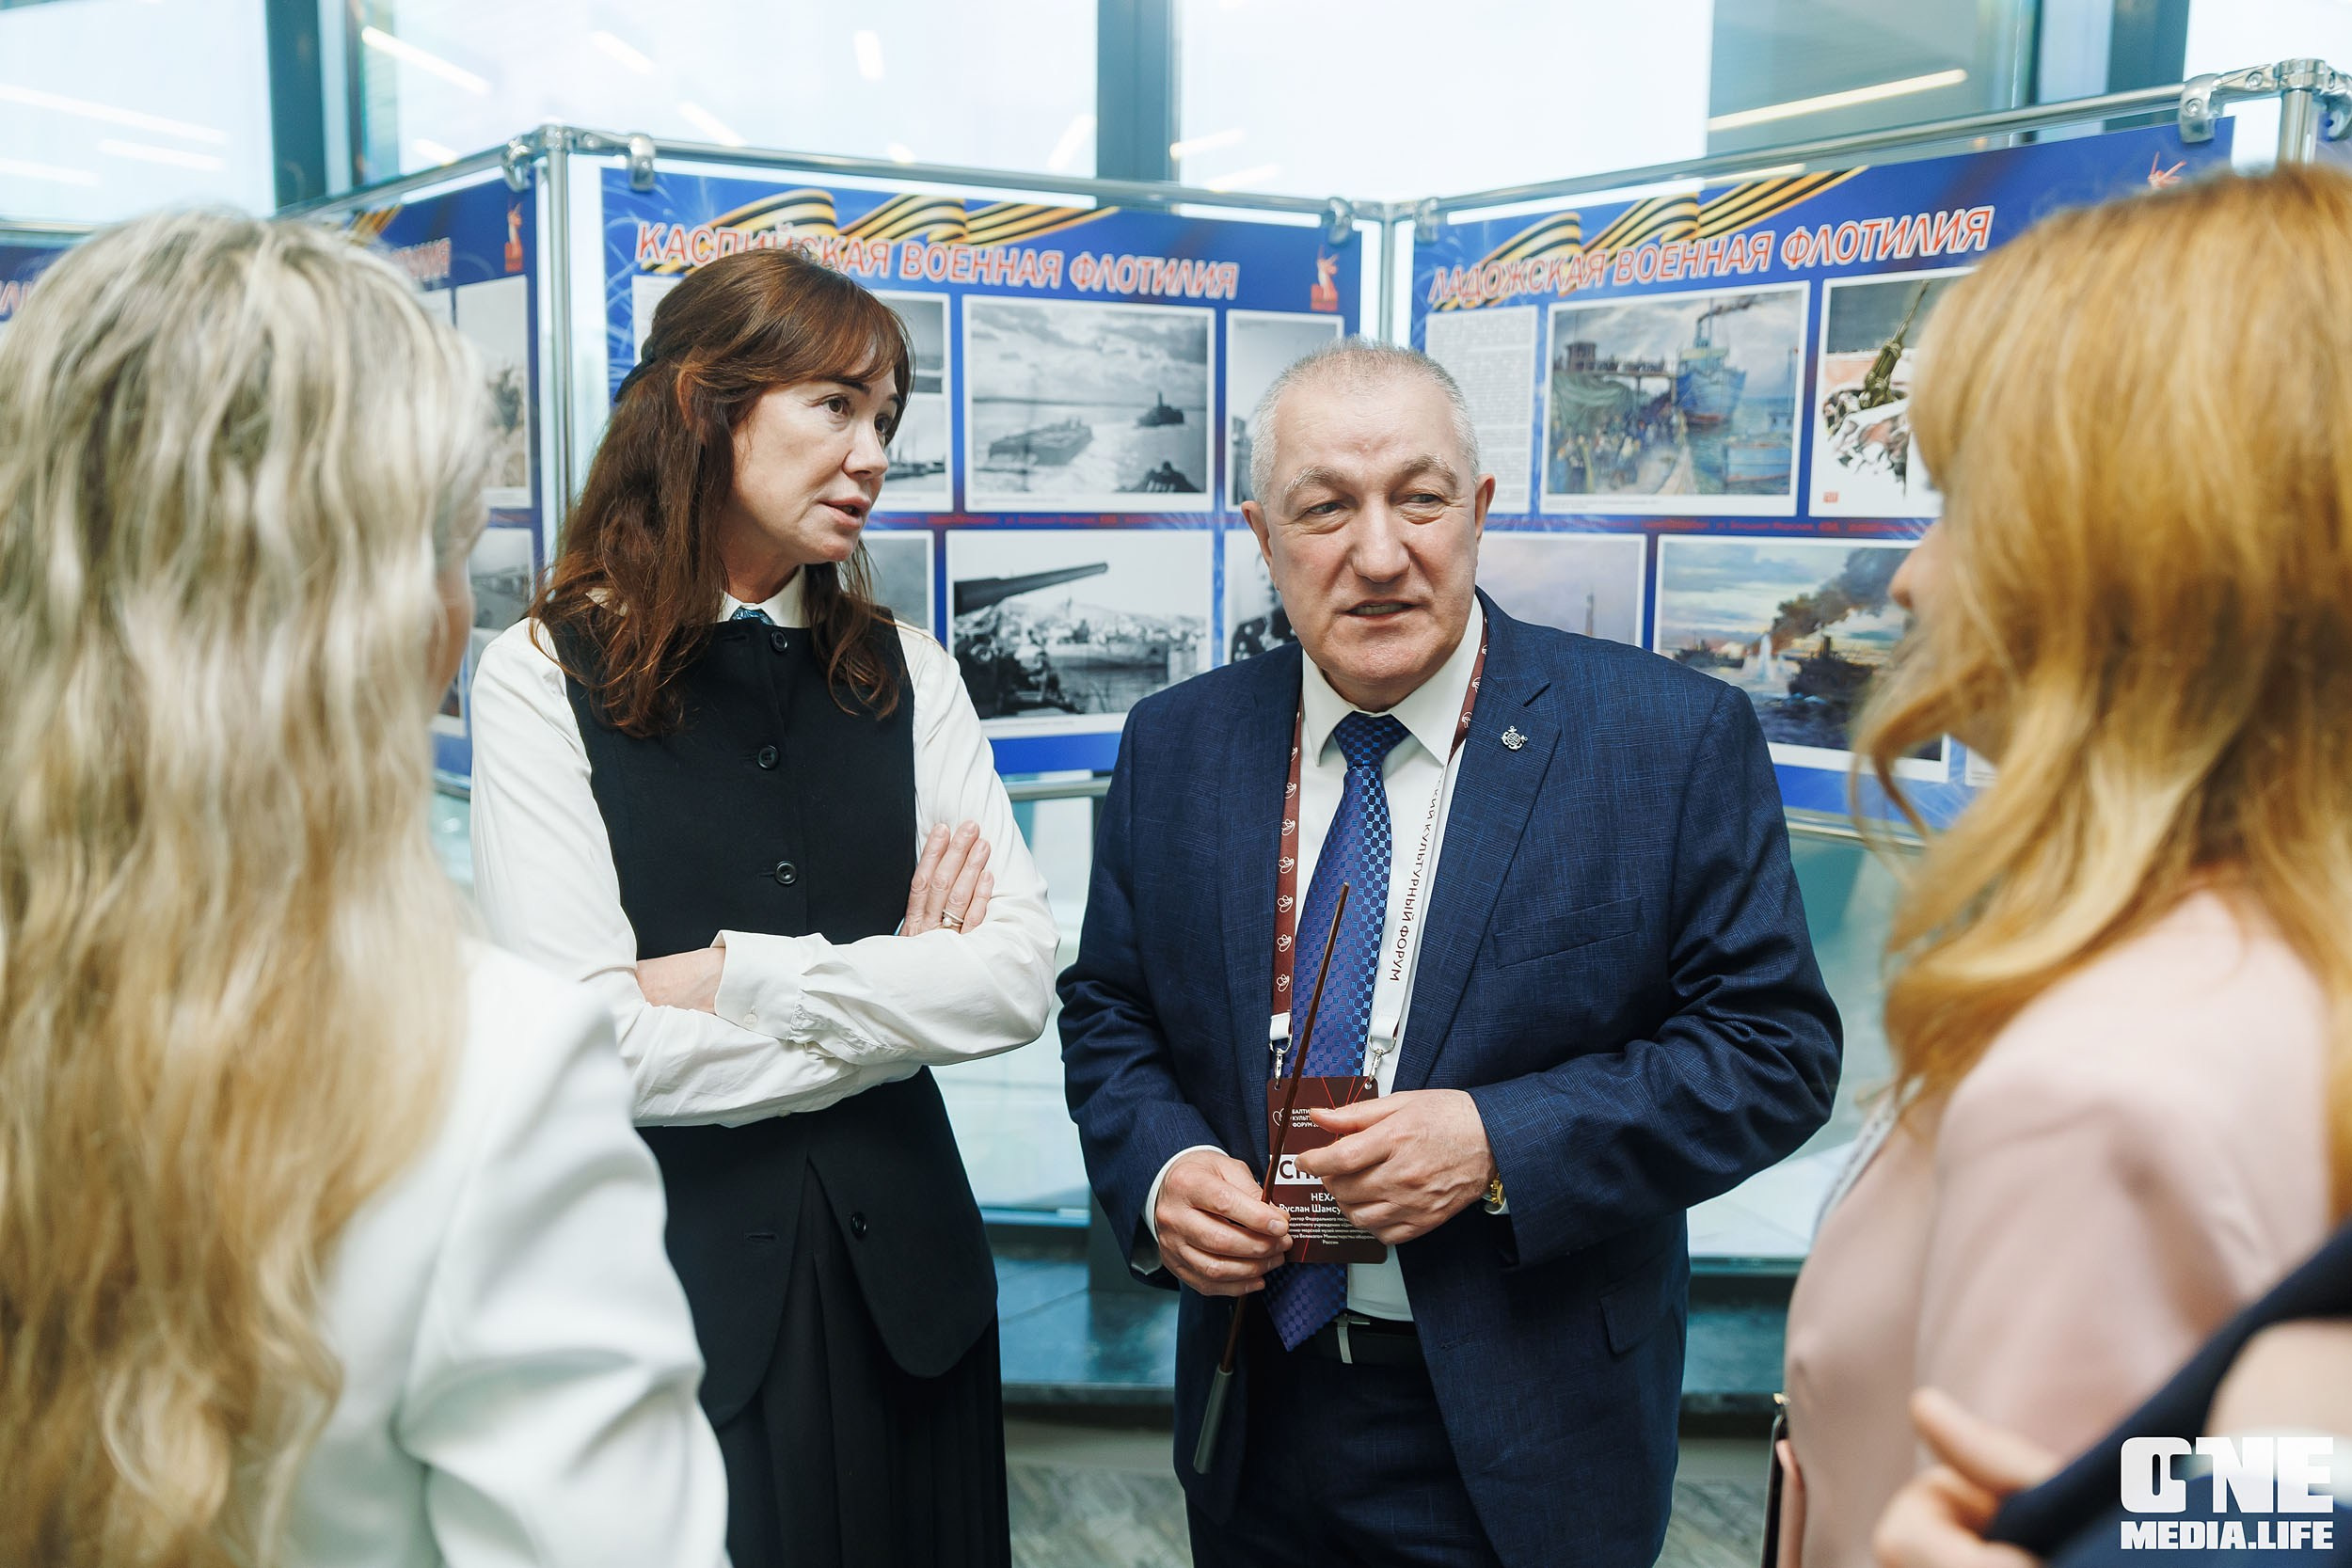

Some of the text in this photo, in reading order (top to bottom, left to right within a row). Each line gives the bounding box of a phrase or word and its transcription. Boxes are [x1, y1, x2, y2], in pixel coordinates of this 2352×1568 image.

[898, 240, 1064, 290] ВОЕННАЯ
[1070, 251, 1240, 300] ФЛОТИЛИЯ
[1427, 205, 1995, 306] ЛАДОЖСКАЯ ВОЕННАЯ ФЛОТИЛИЯ
[1402, 823, 1431, 922] КУЛЬТУРНЫЙ
[1390, 925, 1409, 981] ФОРУМ
[1311, 1204, 1342, 1215] Шамсу
